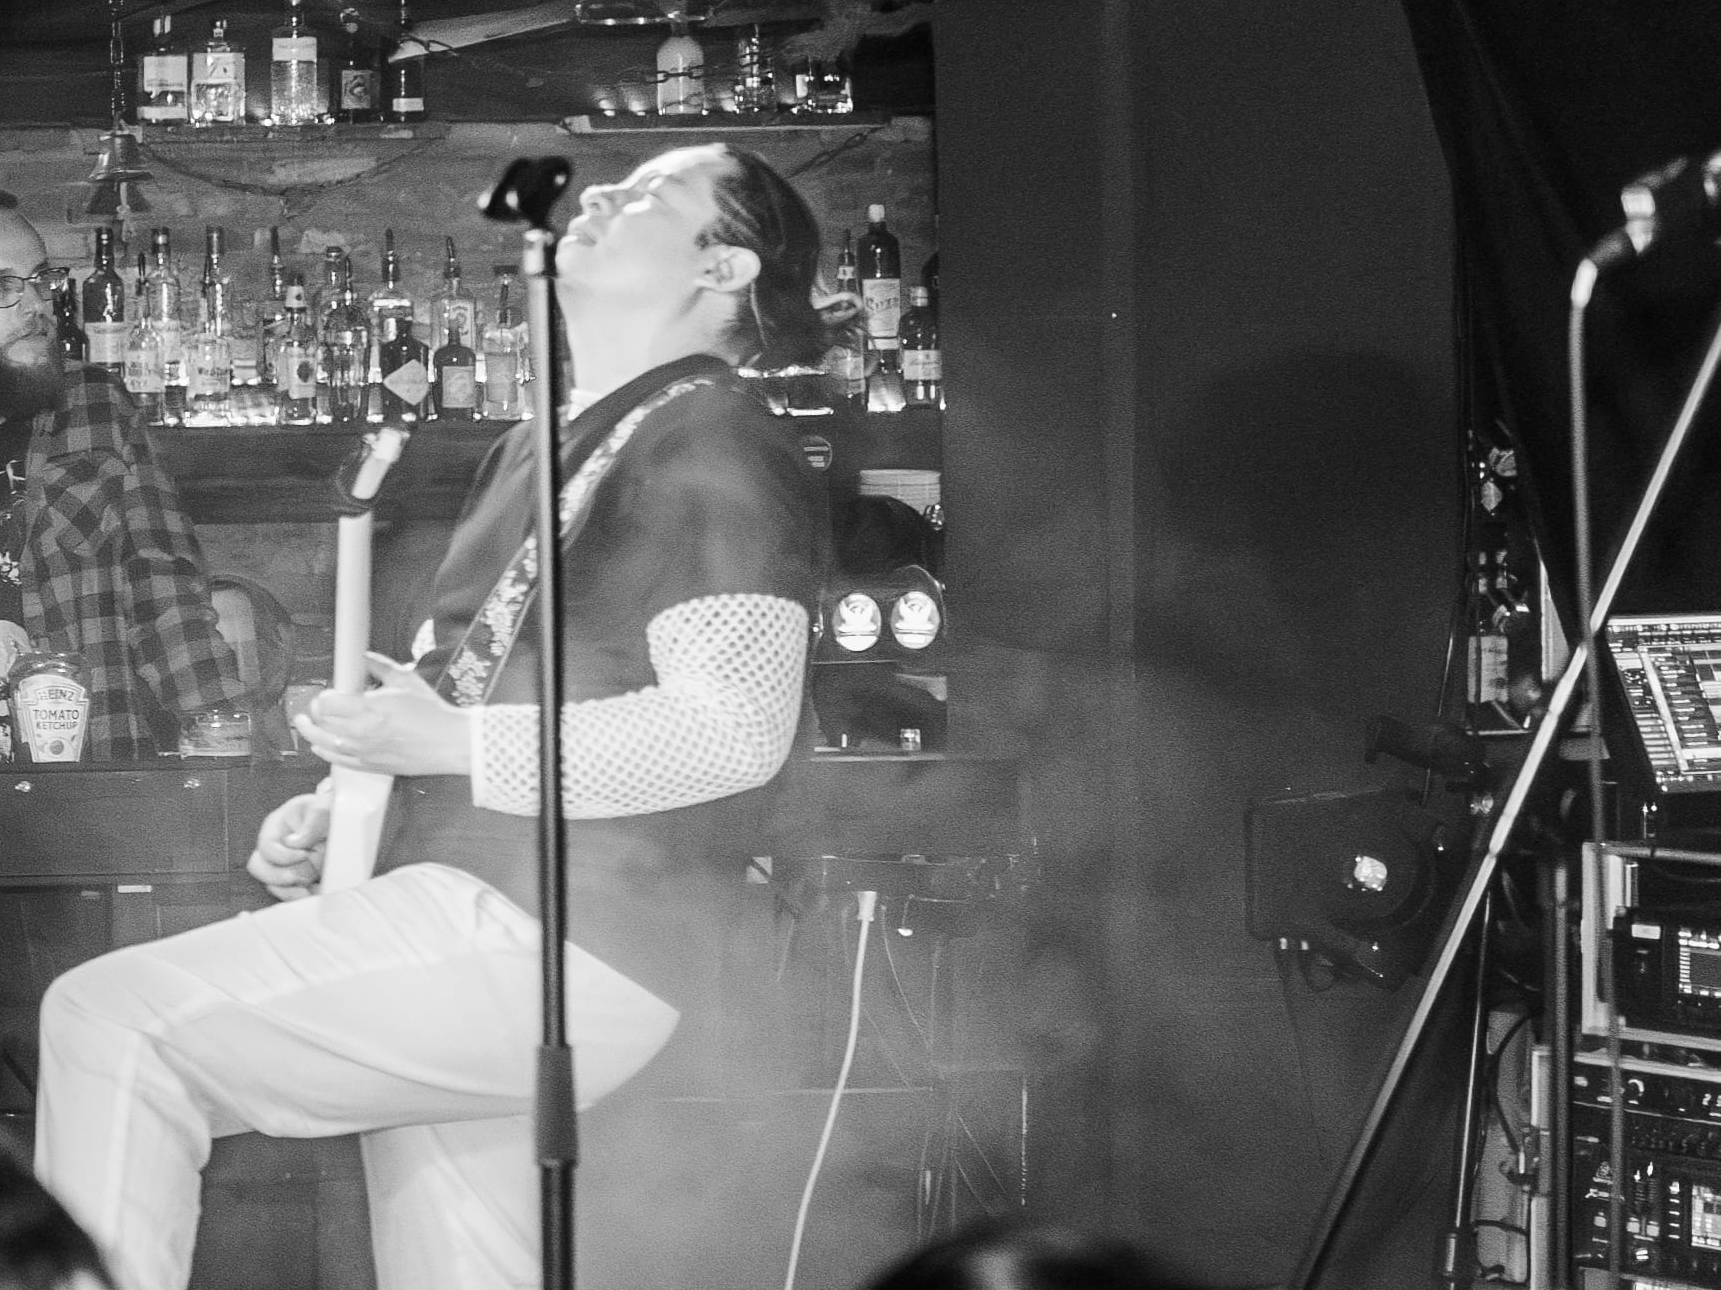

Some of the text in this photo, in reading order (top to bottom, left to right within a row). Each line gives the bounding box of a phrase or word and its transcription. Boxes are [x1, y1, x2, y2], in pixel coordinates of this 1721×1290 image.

[39, 688, 76, 702] HEINZ
[34, 709, 80, 721] TOMATO
[36, 721, 78, 730] KETCHUP
